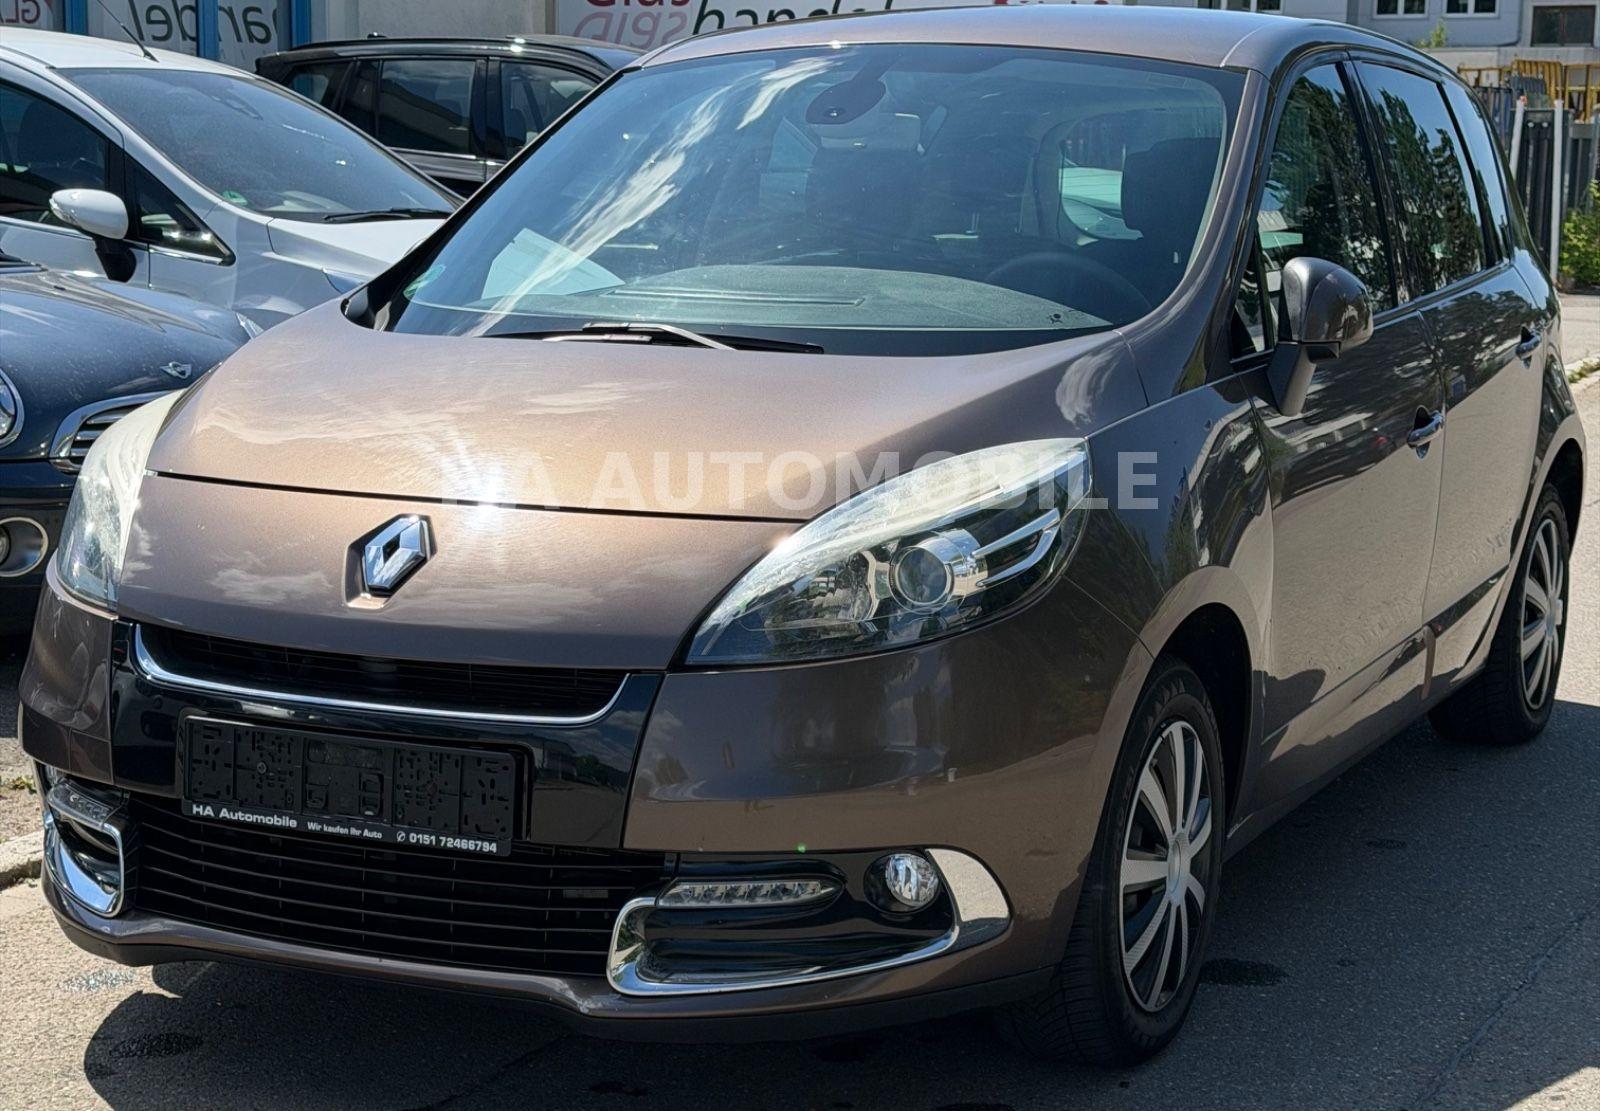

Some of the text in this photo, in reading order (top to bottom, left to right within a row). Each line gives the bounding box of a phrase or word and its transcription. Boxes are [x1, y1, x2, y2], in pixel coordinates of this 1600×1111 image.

[192, 804, 215, 818] HA
[219, 807, 298, 828] Automobile
[307, 821, 322, 831] Wir
[323, 823, 349, 835] kaufen
[363, 828, 383, 839] Auto
[409, 833, 436, 846] 0151
[439, 836, 497, 853] 72466794
